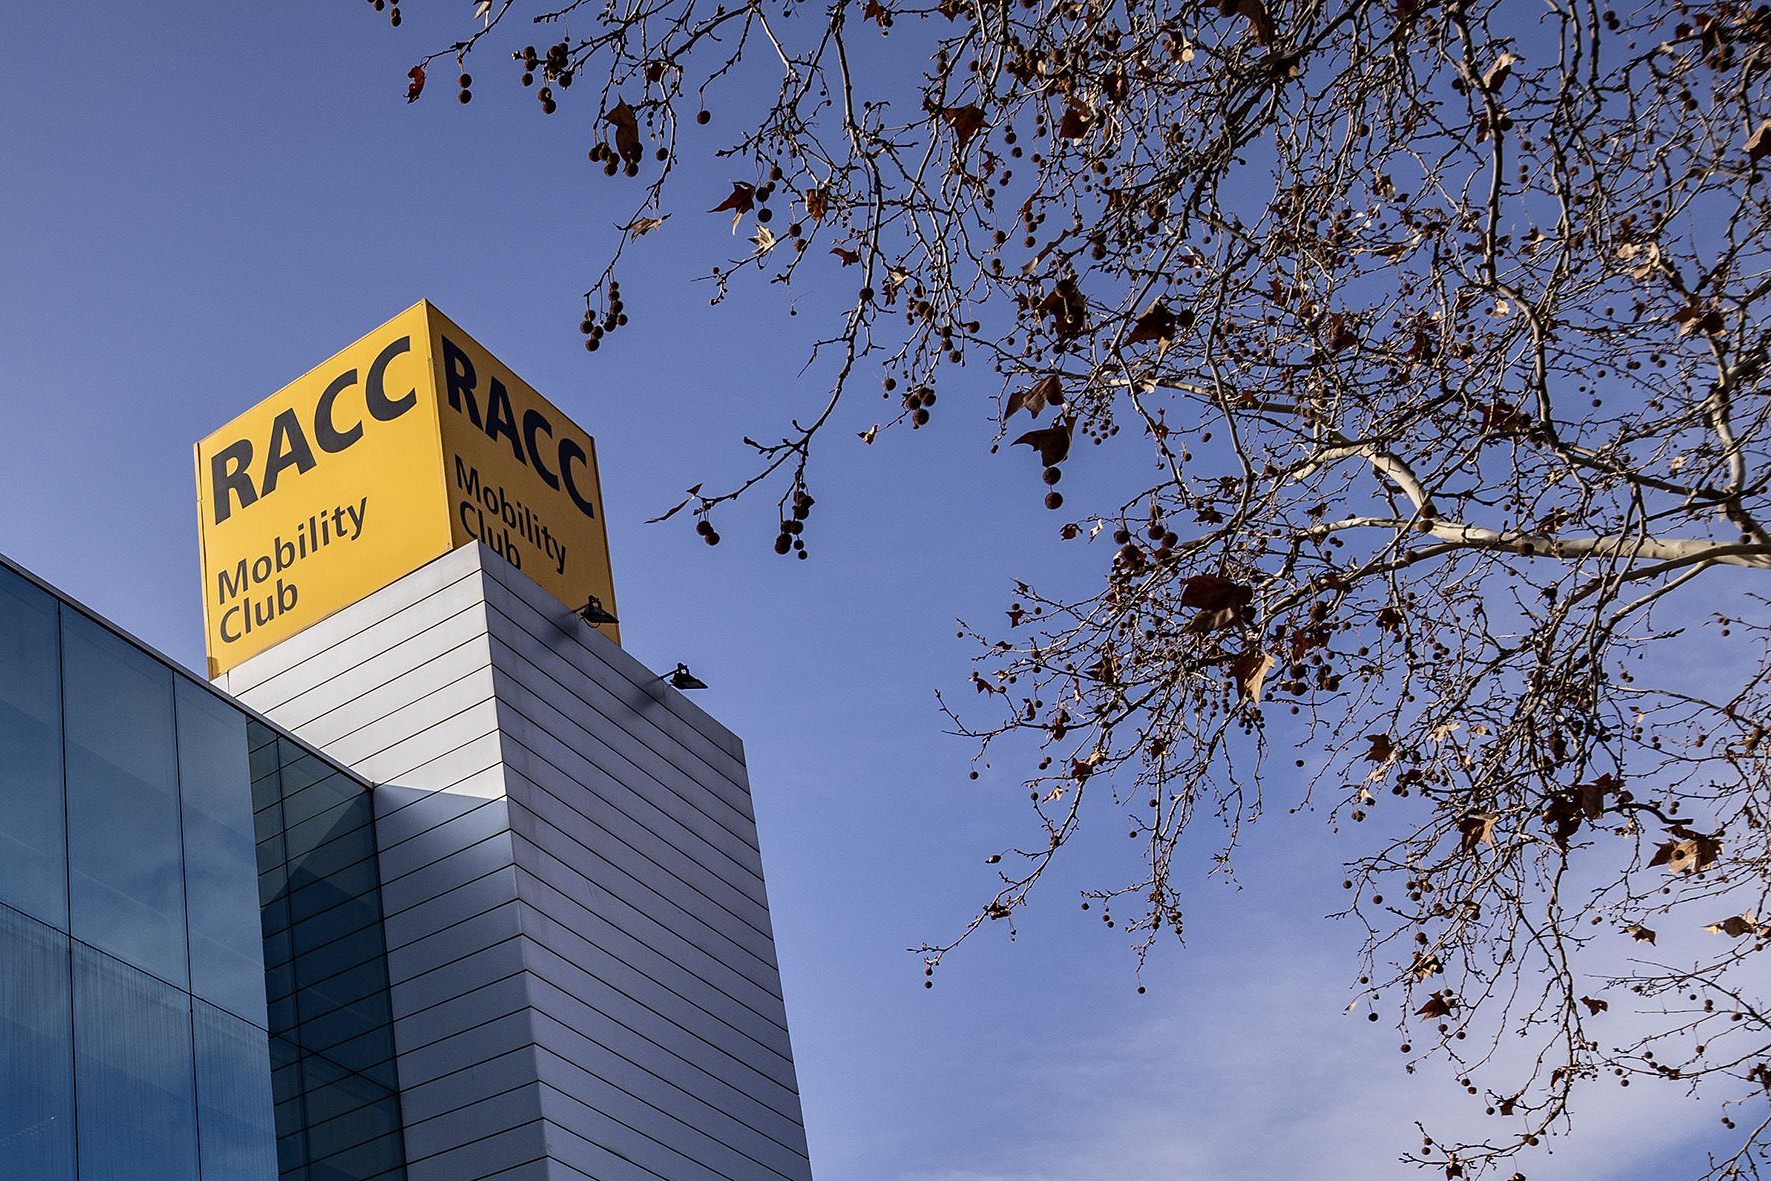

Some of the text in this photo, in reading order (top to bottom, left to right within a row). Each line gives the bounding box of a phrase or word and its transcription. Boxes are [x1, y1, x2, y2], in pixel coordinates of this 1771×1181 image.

[211, 335, 417, 526] RACC
[441, 334, 595, 520] RACC
[218, 497, 368, 605] Mobility
[454, 455, 567, 575] Mobility
[459, 500, 522, 571] Club
[219, 578, 299, 644] Club
